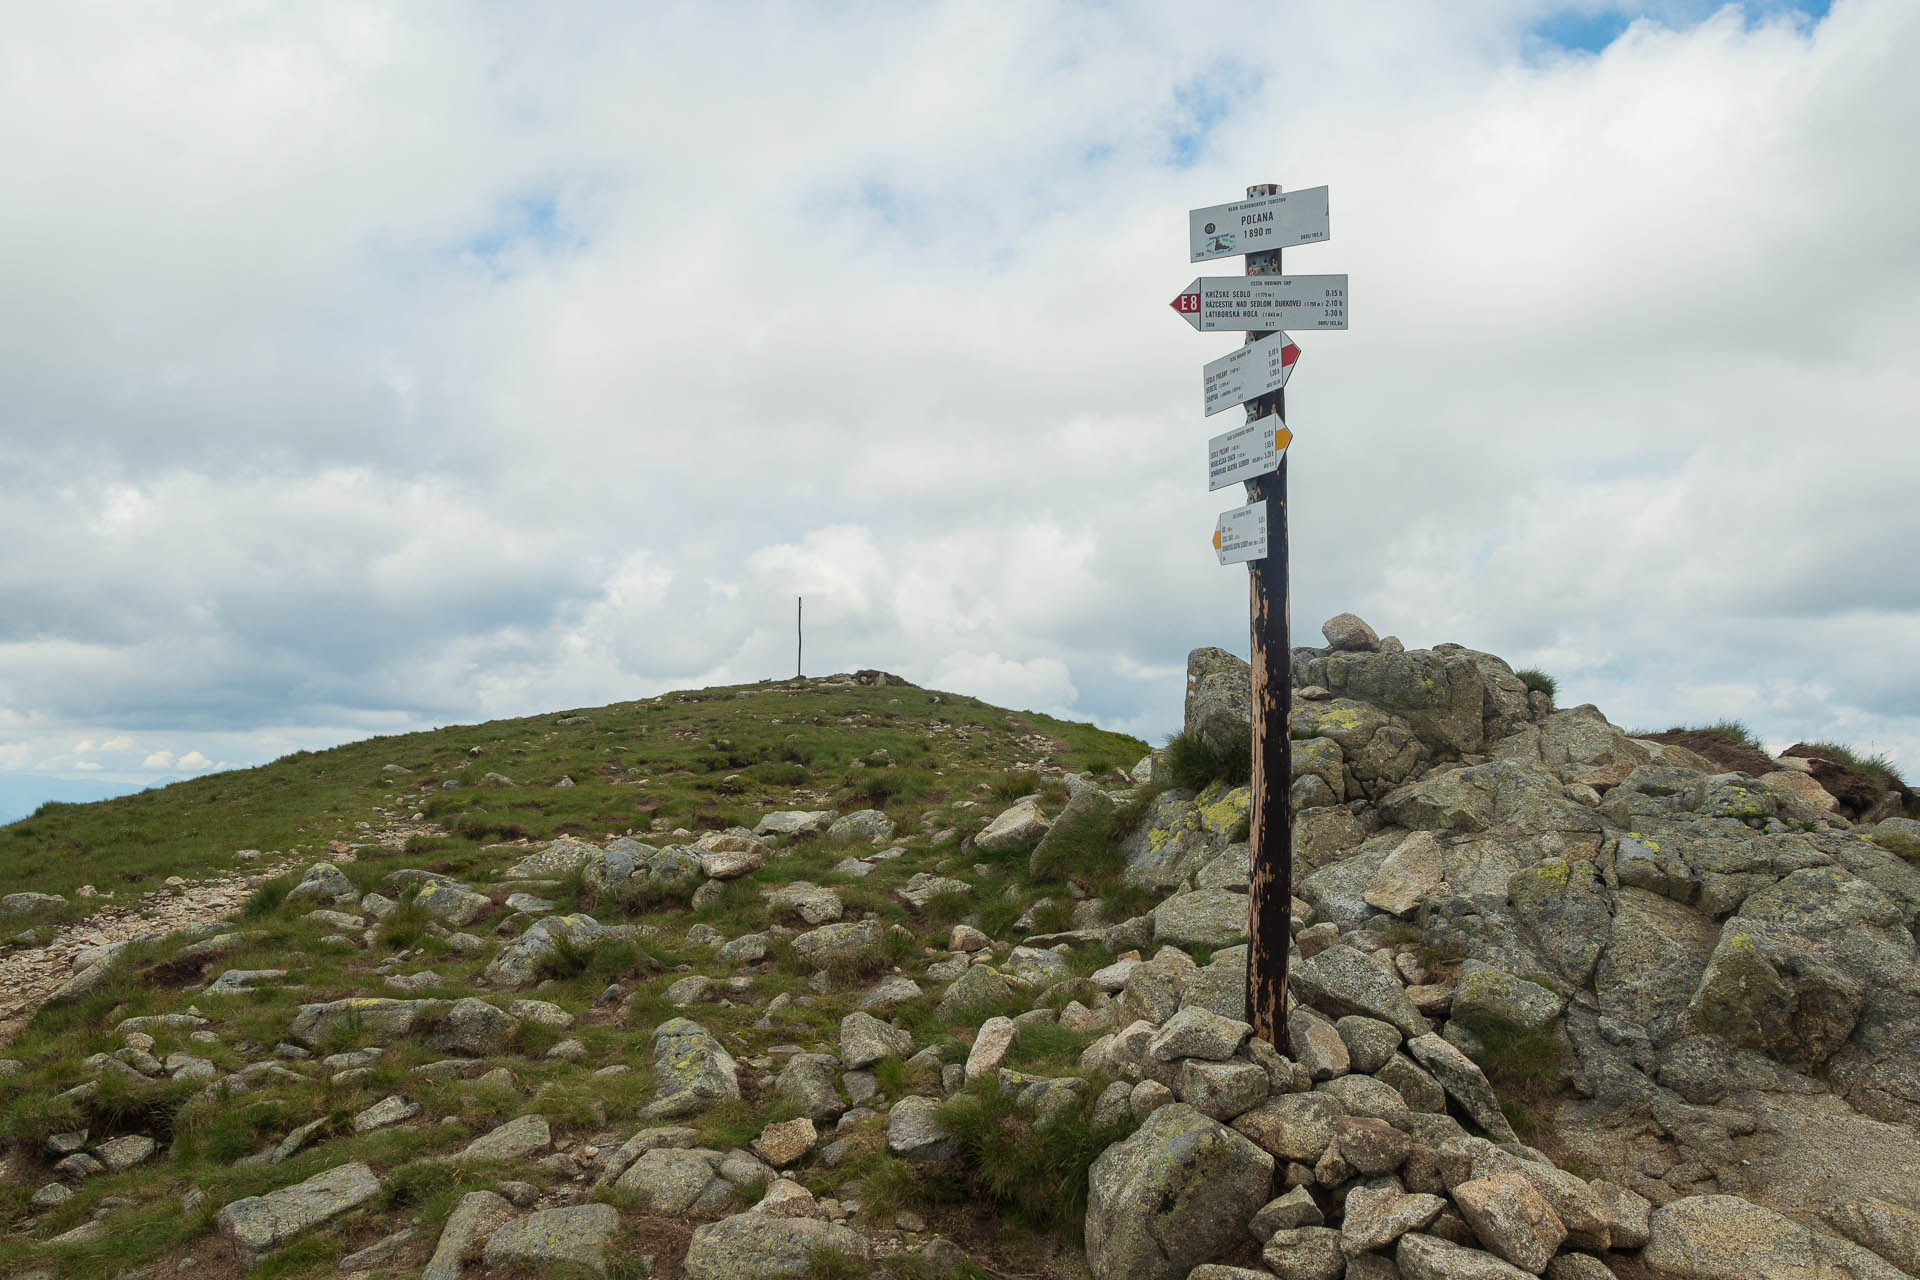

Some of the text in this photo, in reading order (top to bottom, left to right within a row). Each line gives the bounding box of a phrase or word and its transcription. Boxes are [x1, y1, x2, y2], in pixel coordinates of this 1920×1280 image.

[1265, 227, 1272, 235] m
[1232, 290, 1251, 298] SEDLO
[1236, 300, 1247, 308] NAD
[1250, 300, 1272, 308] SEDLOM
[1205, 310, 1240, 318] LATIBORSKÁ
